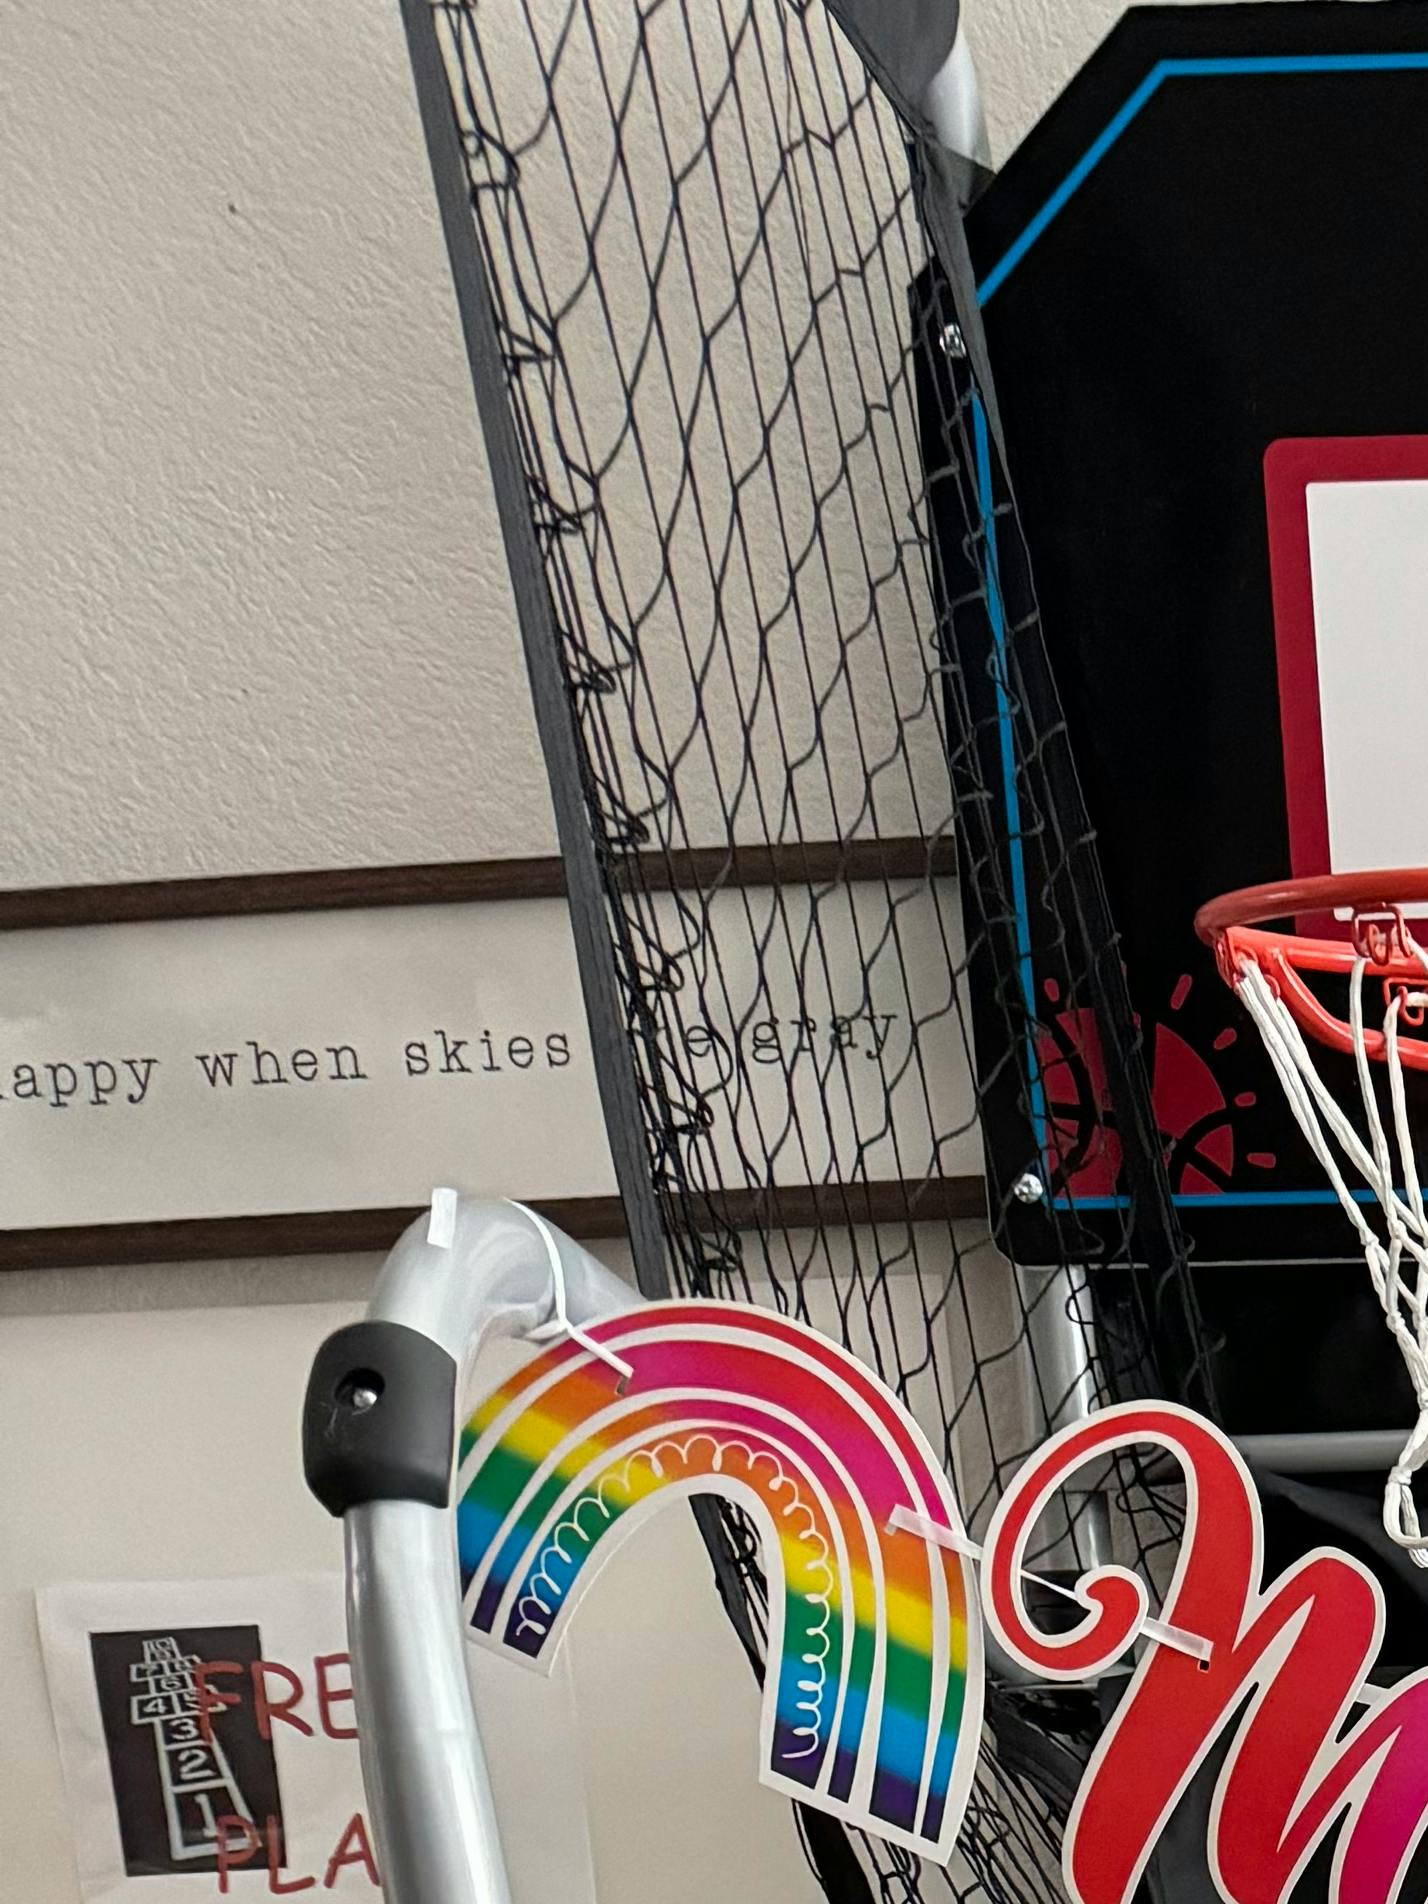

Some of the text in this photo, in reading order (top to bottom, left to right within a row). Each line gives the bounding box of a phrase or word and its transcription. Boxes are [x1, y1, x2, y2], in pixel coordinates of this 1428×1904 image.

[0, 1058, 160, 1107] appy
[195, 1041, 368, 1087] when
[405, 1030, 571, 1077] skies
[143, 1698, 167, 1713] 4
[194, 1653, 360, 1747] FRE
[170, 1718, 199, 1740] 3
[178, 1749, 217, 1780] 2
[195, 1794, 218, 1838] 1
[216, 1813, 382, 1894] PLA
